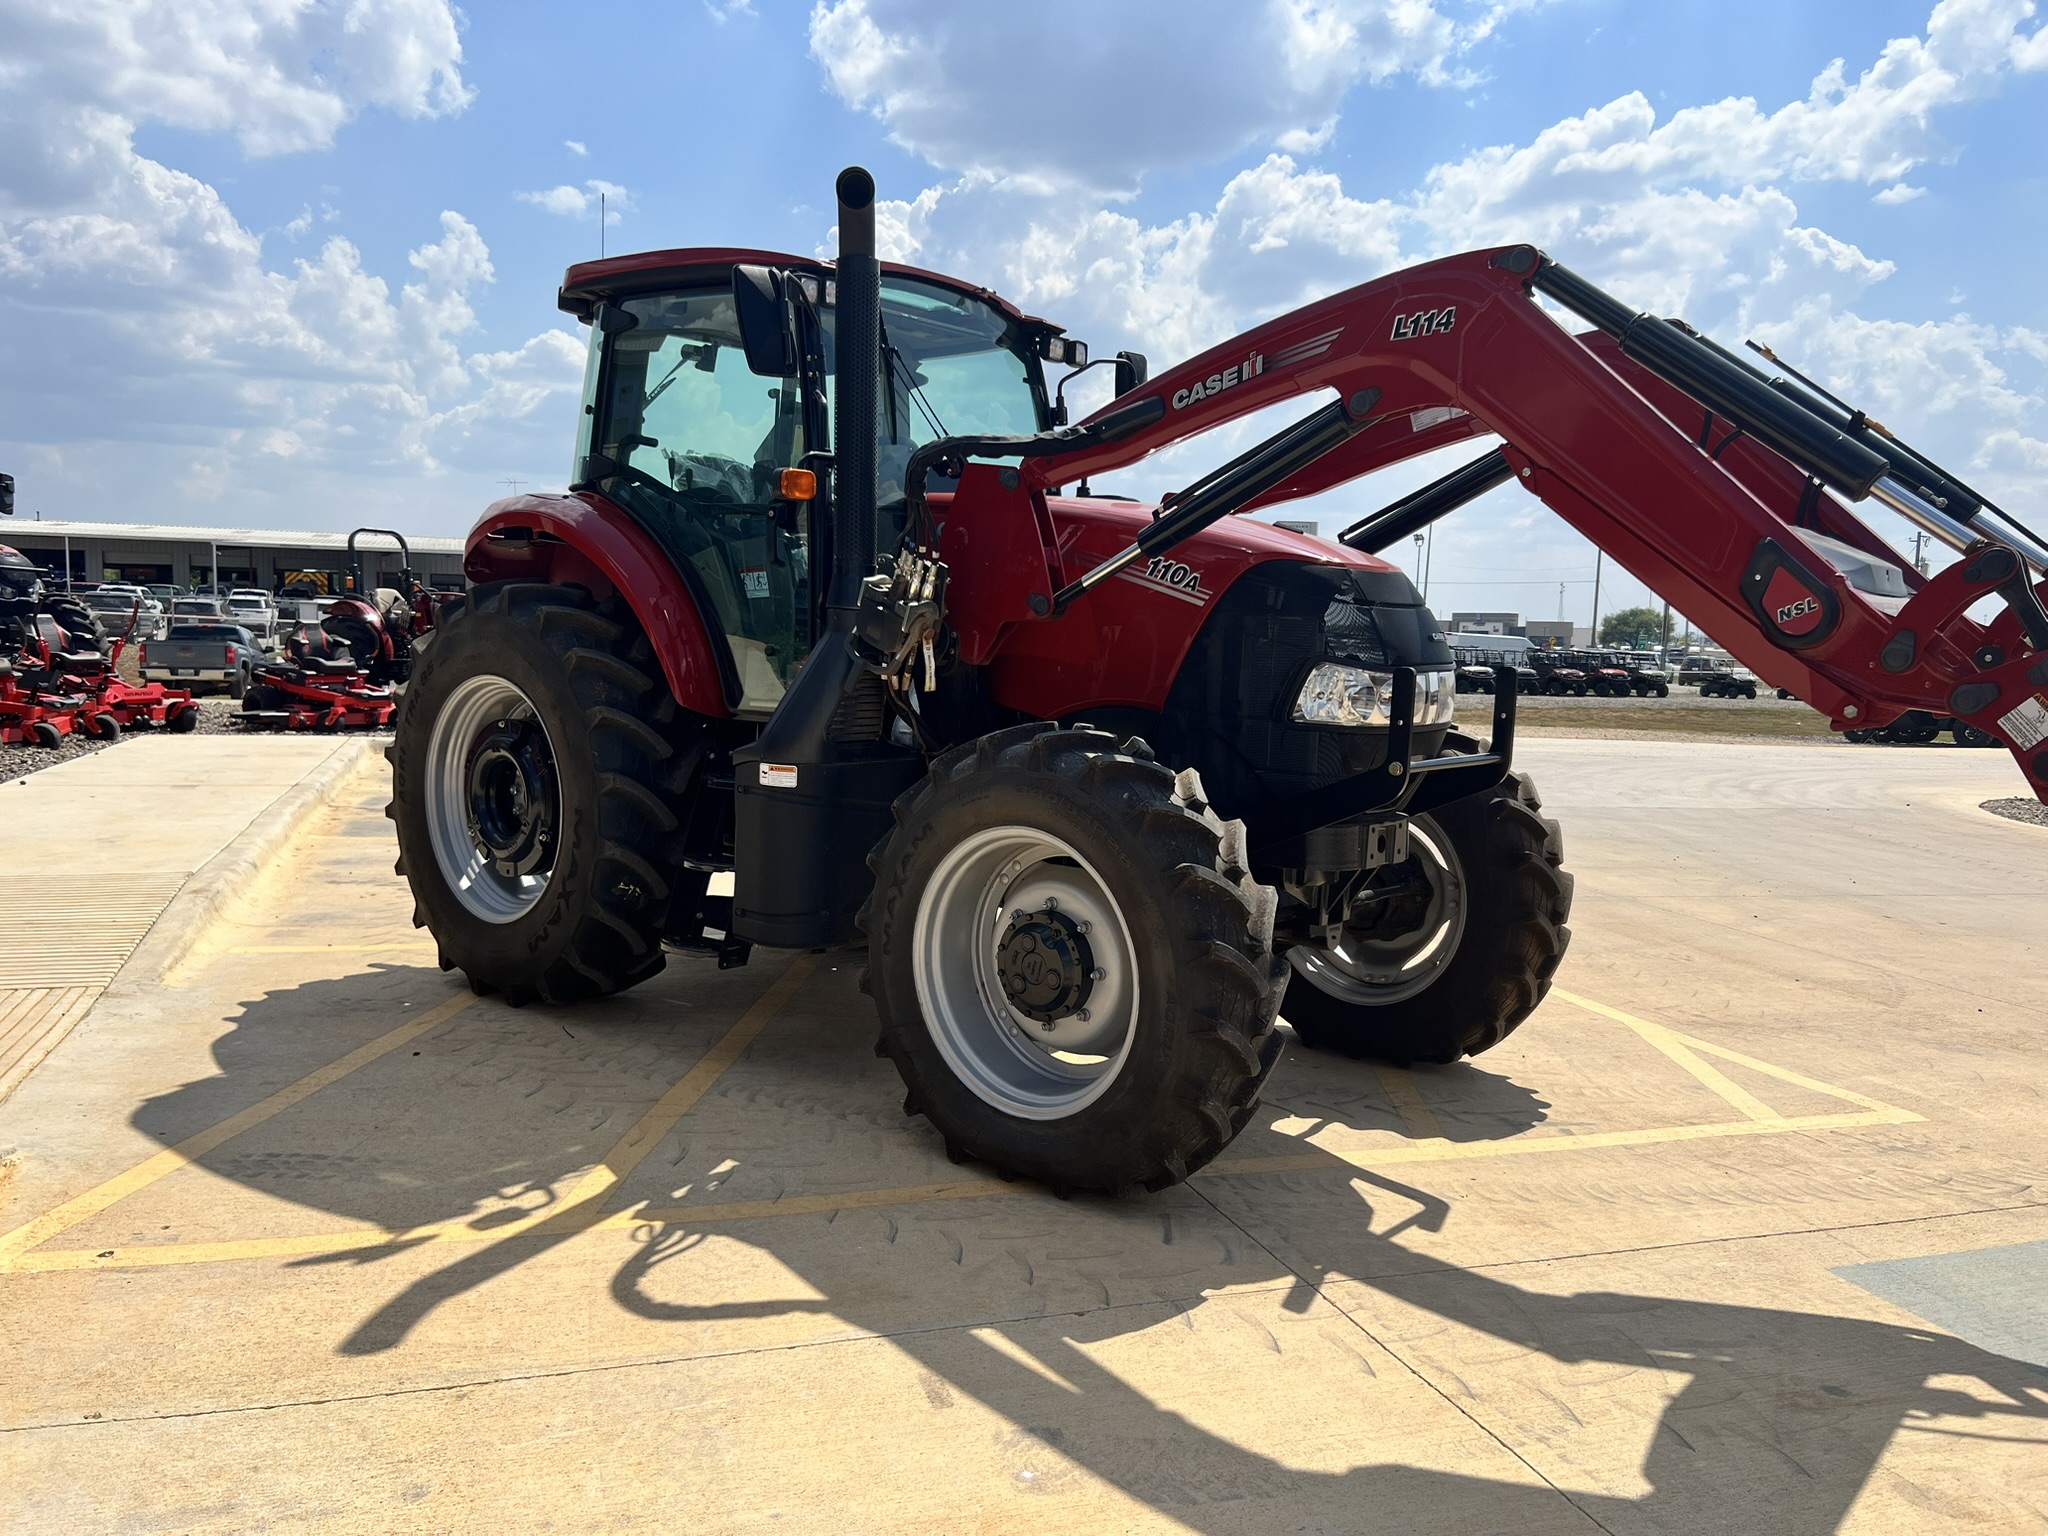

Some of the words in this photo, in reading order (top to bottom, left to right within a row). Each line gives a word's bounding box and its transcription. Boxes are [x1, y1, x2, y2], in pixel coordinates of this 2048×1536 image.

[1390, 306, 1456, 341] L114
[1172, 366, 1239, 411] CASE
[1146, 555, 1202, 594] 110A
[1777, 596, 1820, 624] NSL
